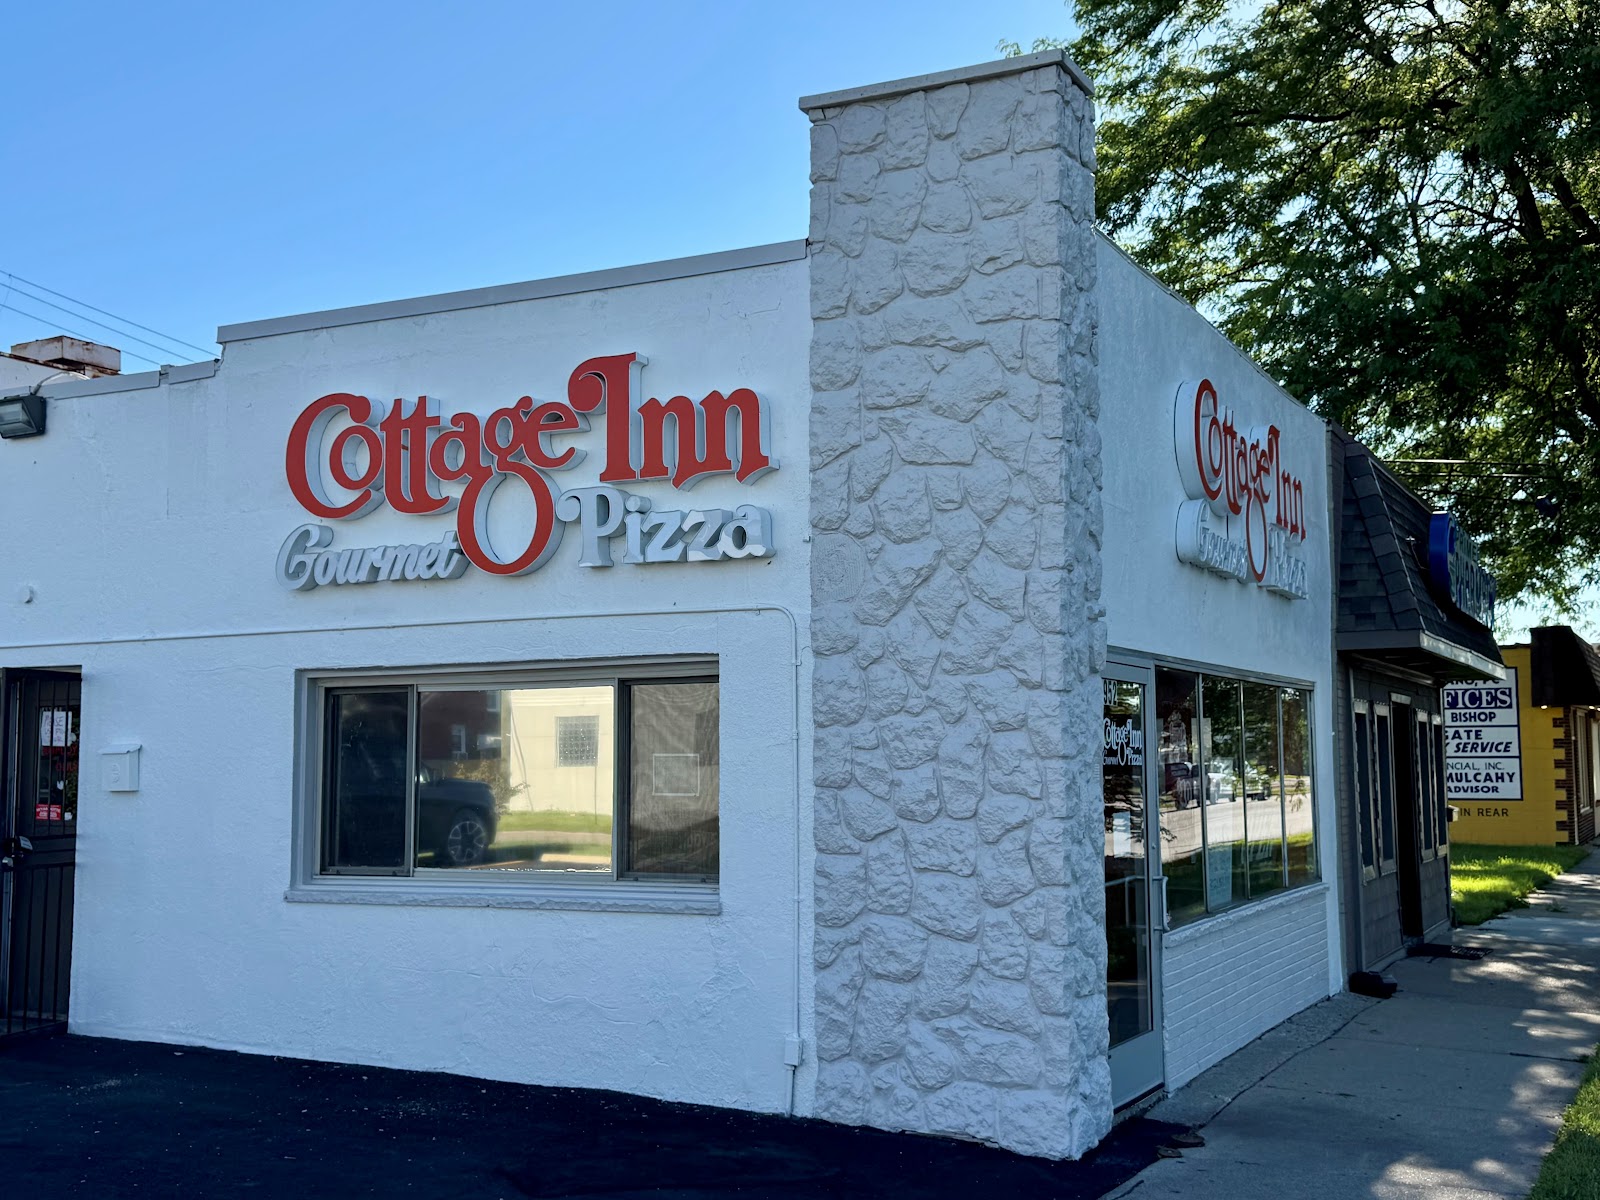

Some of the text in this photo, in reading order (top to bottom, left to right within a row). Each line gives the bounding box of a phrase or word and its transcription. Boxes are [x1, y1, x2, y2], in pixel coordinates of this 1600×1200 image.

[286, 352, 769, 576] Cottage Inn
[1195, 378, 1271, 583] Cottage
[1267, 424, 1307, 542] Inn
[556, 486, 769, 568] Pizza
[275, 523, 460, 590] Gourmet
[1451, 711, 1496, 722] BISHOP
[1103, 717, 1142, 766] Cottage Inn
[1454, 742, 1512, 753] SERVICE
[1484, 762, 1505, 771] INC.
[1477, 808, 1509, 817] REAR
